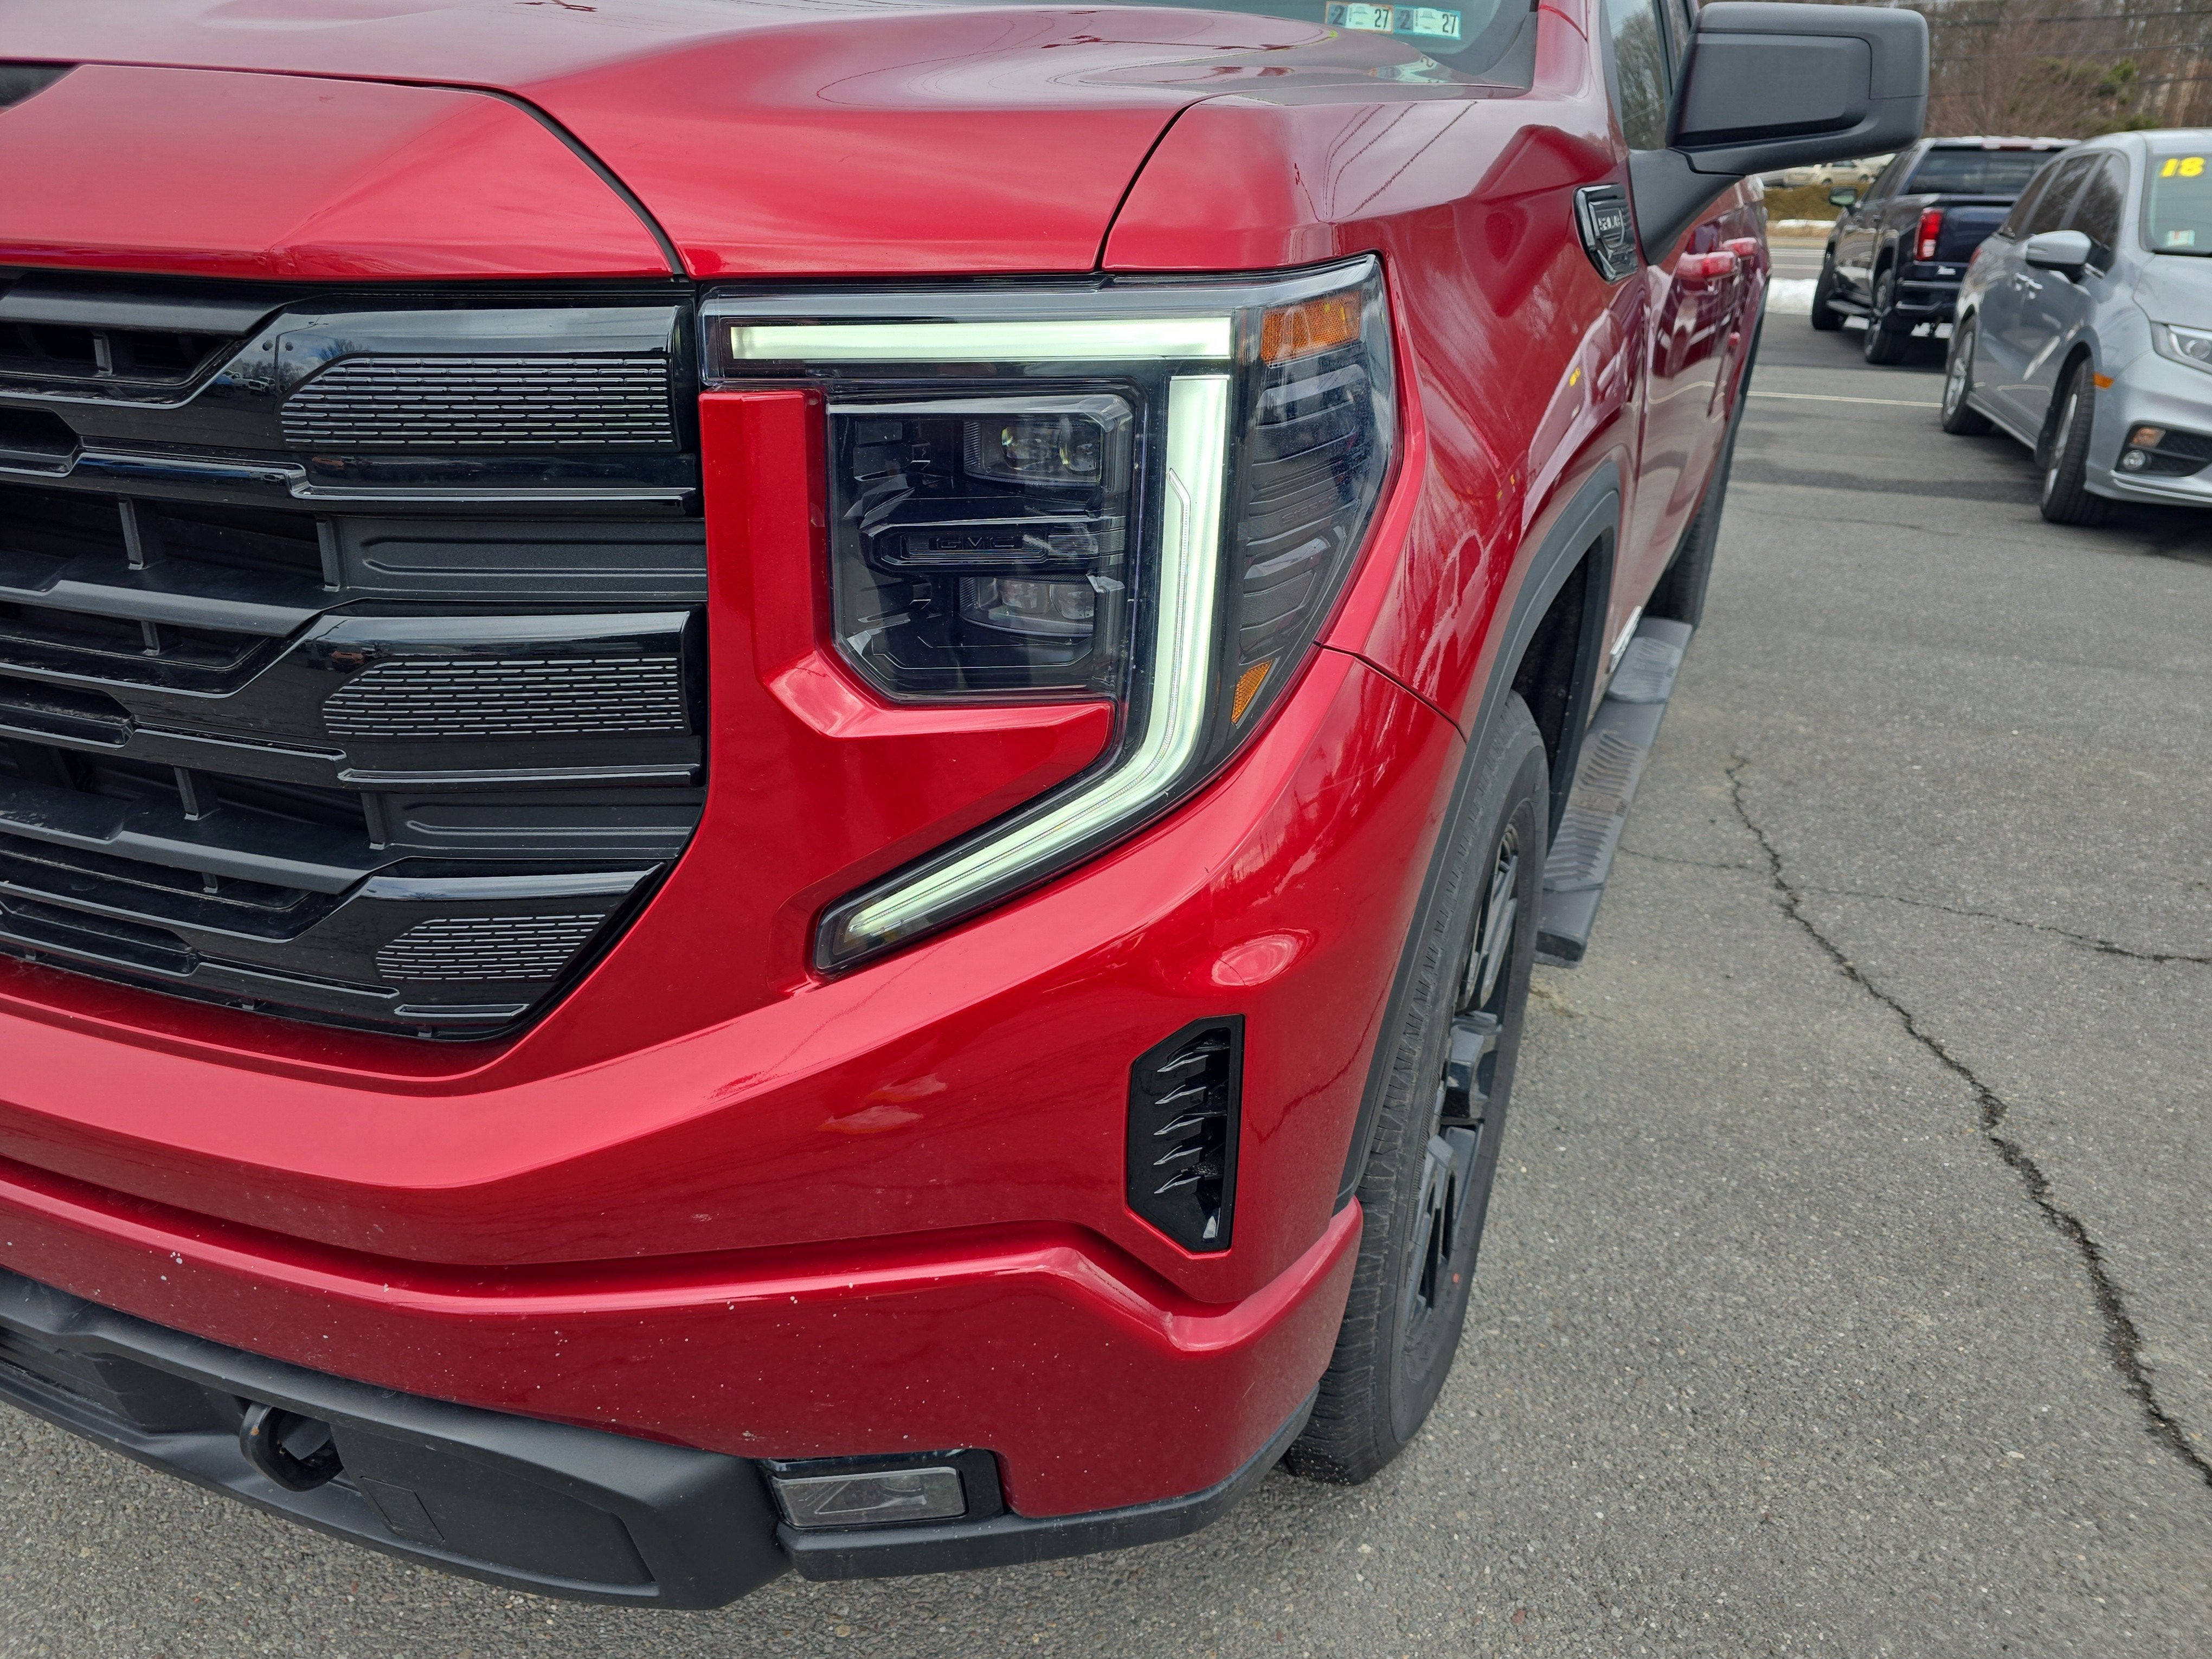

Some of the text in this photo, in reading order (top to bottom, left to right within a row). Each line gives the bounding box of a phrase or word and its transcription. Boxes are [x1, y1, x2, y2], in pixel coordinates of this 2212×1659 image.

[1332, 5, 1345, 25] 2
[1375, 8, 1390, 29] 27
[1399, 9, 1411, 30] 2
[1442, 13, 1457, 35] 27
[2160, 156, 2207, 178] 18
[936, 537, 1015, 550] GMC
